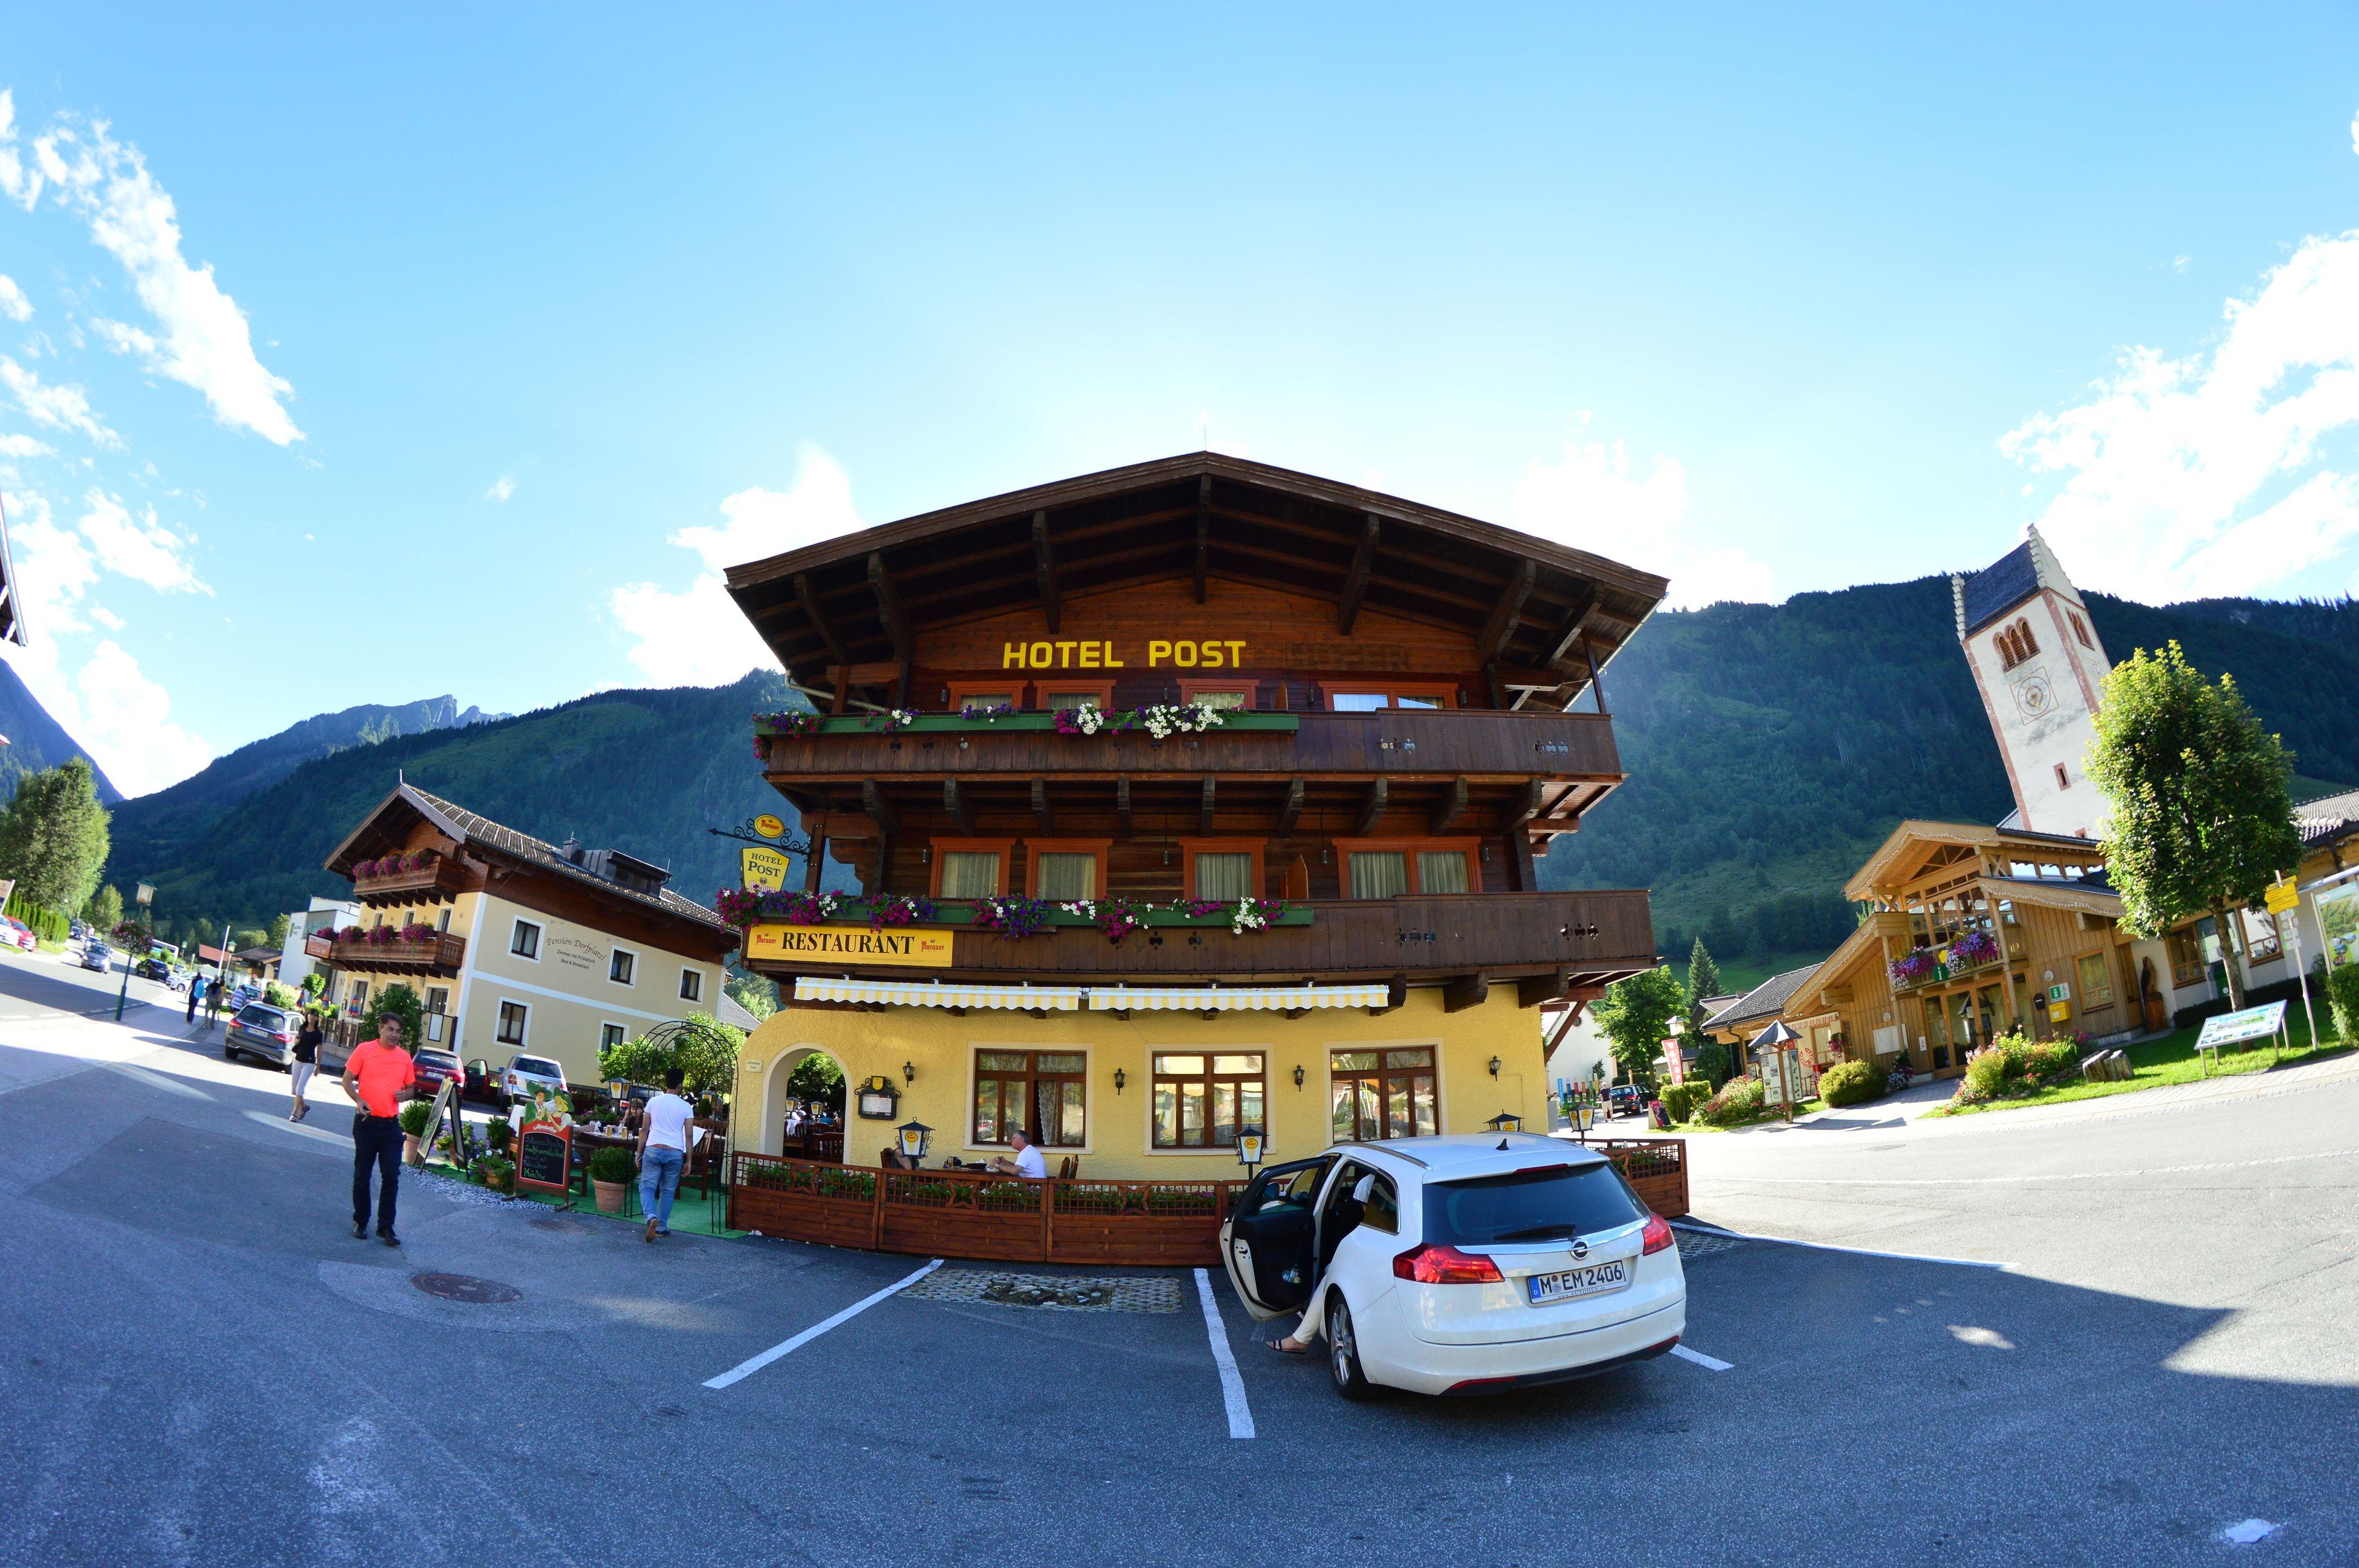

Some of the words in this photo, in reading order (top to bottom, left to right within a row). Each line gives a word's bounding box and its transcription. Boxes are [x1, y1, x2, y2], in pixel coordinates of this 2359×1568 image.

[1003, 641, 1124, 668] HOTEL
[1149, 640, 1246, 668] POST
[751, 852, 783, 865] HOTEL
[748, 860, 781, 877] POST
[546, 937, 572, 946] Pension
[756, 934, 777, 945] Murauer
[781, 932, 915, 954] RESTAURANT
[921, 940, 945, 952] Murauer
[572, 961, 590, 969] Breakfast
[524, 1167, 546, 1180] Küche
[1539, 1276, 1552, 1294] M
[1561, 1271, 1584, 1290] EM
[1586, 1265, 1622, 1285] 2406
